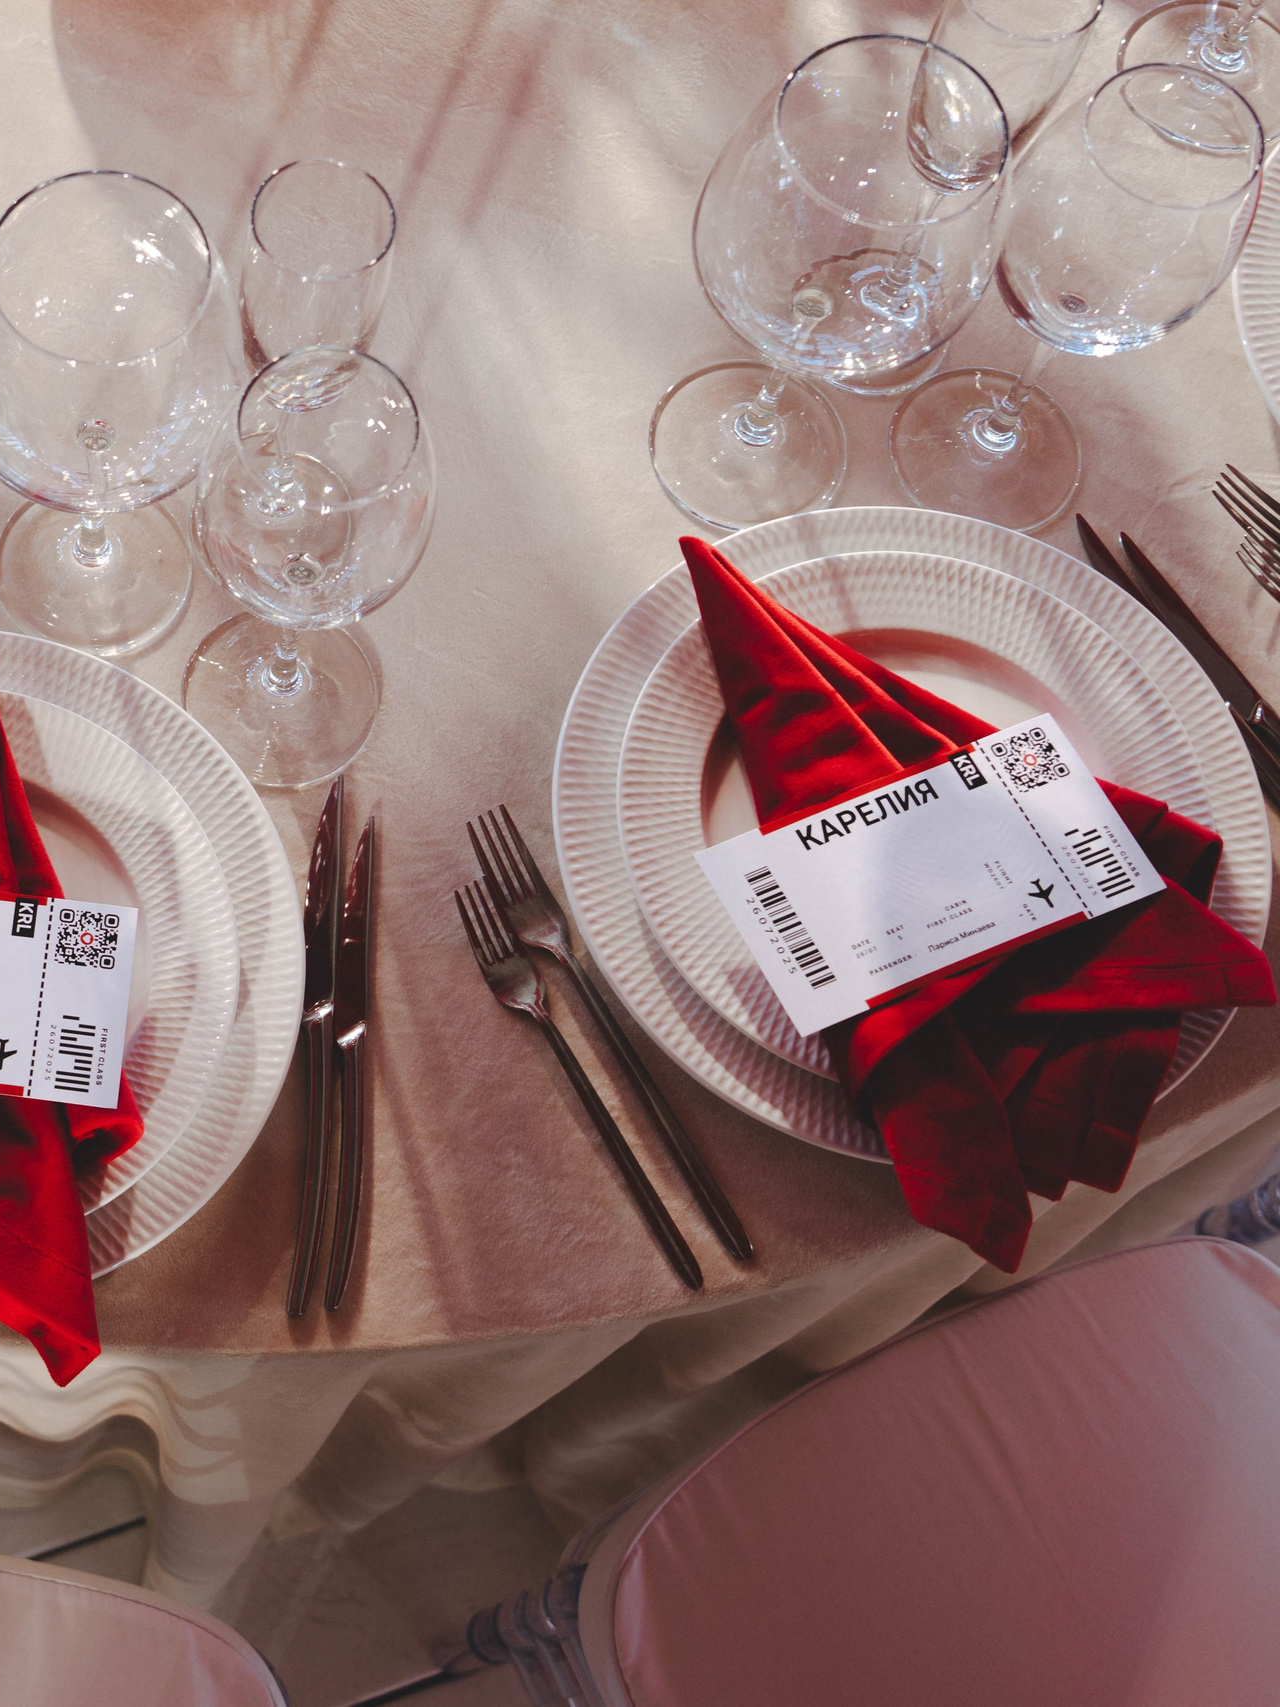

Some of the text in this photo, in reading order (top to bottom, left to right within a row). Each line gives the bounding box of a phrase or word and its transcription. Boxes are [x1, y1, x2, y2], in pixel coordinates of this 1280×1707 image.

[953, 754, 981, 786] KRL
[795, 778, 939, 850] КАРЕЛИЯ
[1103, 825, 1140, 878] FIRST CLASS
[994, 860, 1013, 885] FLIGHT
[1061, 845, 1097, 896] 26072025
[16, 902, 34, 933] KRL
[926, 907, 973, 929] FIRST CLASS
[944, 900, 967, 912] CABIN
[1022, 903, 1037, 922] GATE
[746, 897, 798, 975] 26072025
[851, 938, 871, 951] DATE
[886, 924, 904, 936] SEAT
[927, 921, 996, 953] Лариса Минаева
[869, 954, 913, 976] PASSENGER
[44, 1024, 57, 1081] 26072025
[95, 1027, 108, 1086] FIRST CLASS
